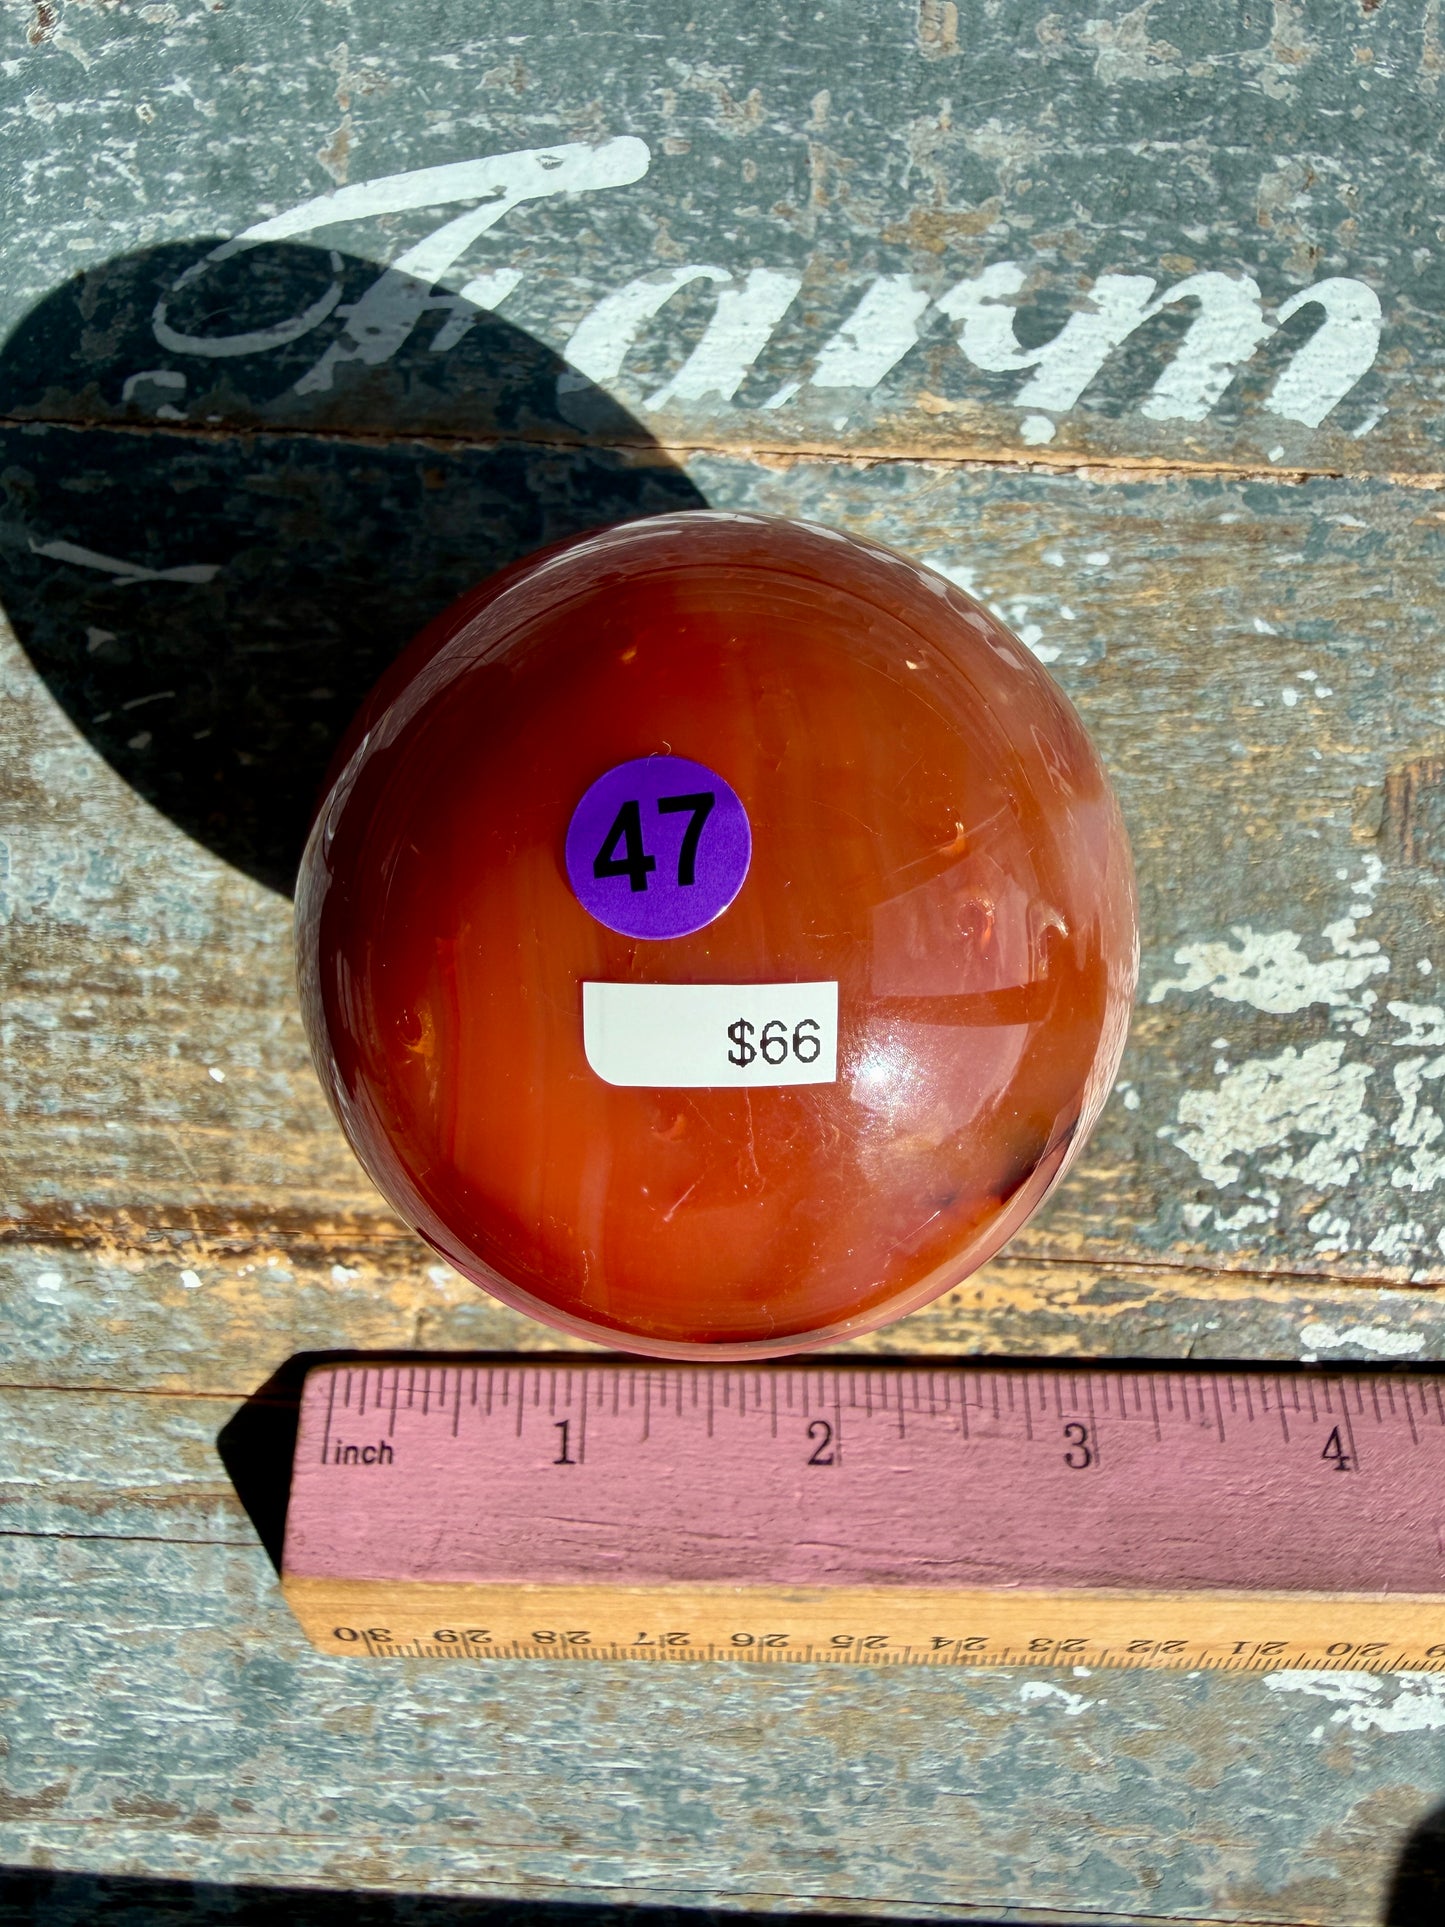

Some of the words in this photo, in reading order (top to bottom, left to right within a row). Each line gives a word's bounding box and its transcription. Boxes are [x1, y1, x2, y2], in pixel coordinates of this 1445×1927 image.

[593, 792, 716, 893] 47
[727, 1017, 821, 1068] $66
[334, 1439, 394, 1465] inch
[553, 1419, 576, 1465] 1
[807, 1420, 834, 1466] 2
[1064, 1422, 1092, 1469] 3
[1321, 1425, 1351, 1472] 4
[333, 1627, 394, 1643] 30
[433, 1629, 493, 1645] 29
[531, 1630, 592, 1646] 28
[631, 1631, 691, 1647] 27
[730, 1632, 790, 1648] 26
[830, 1634, 890, 1650] 25
[930, 1635, 990, 1651] 24
[1028, 1636, 1091, 1653] 23
[1126, 1639, 1190, 1655] 22
[1231, 1640, 1290, 1657] 21
[1325, 1642, 1391, 1658] 20
